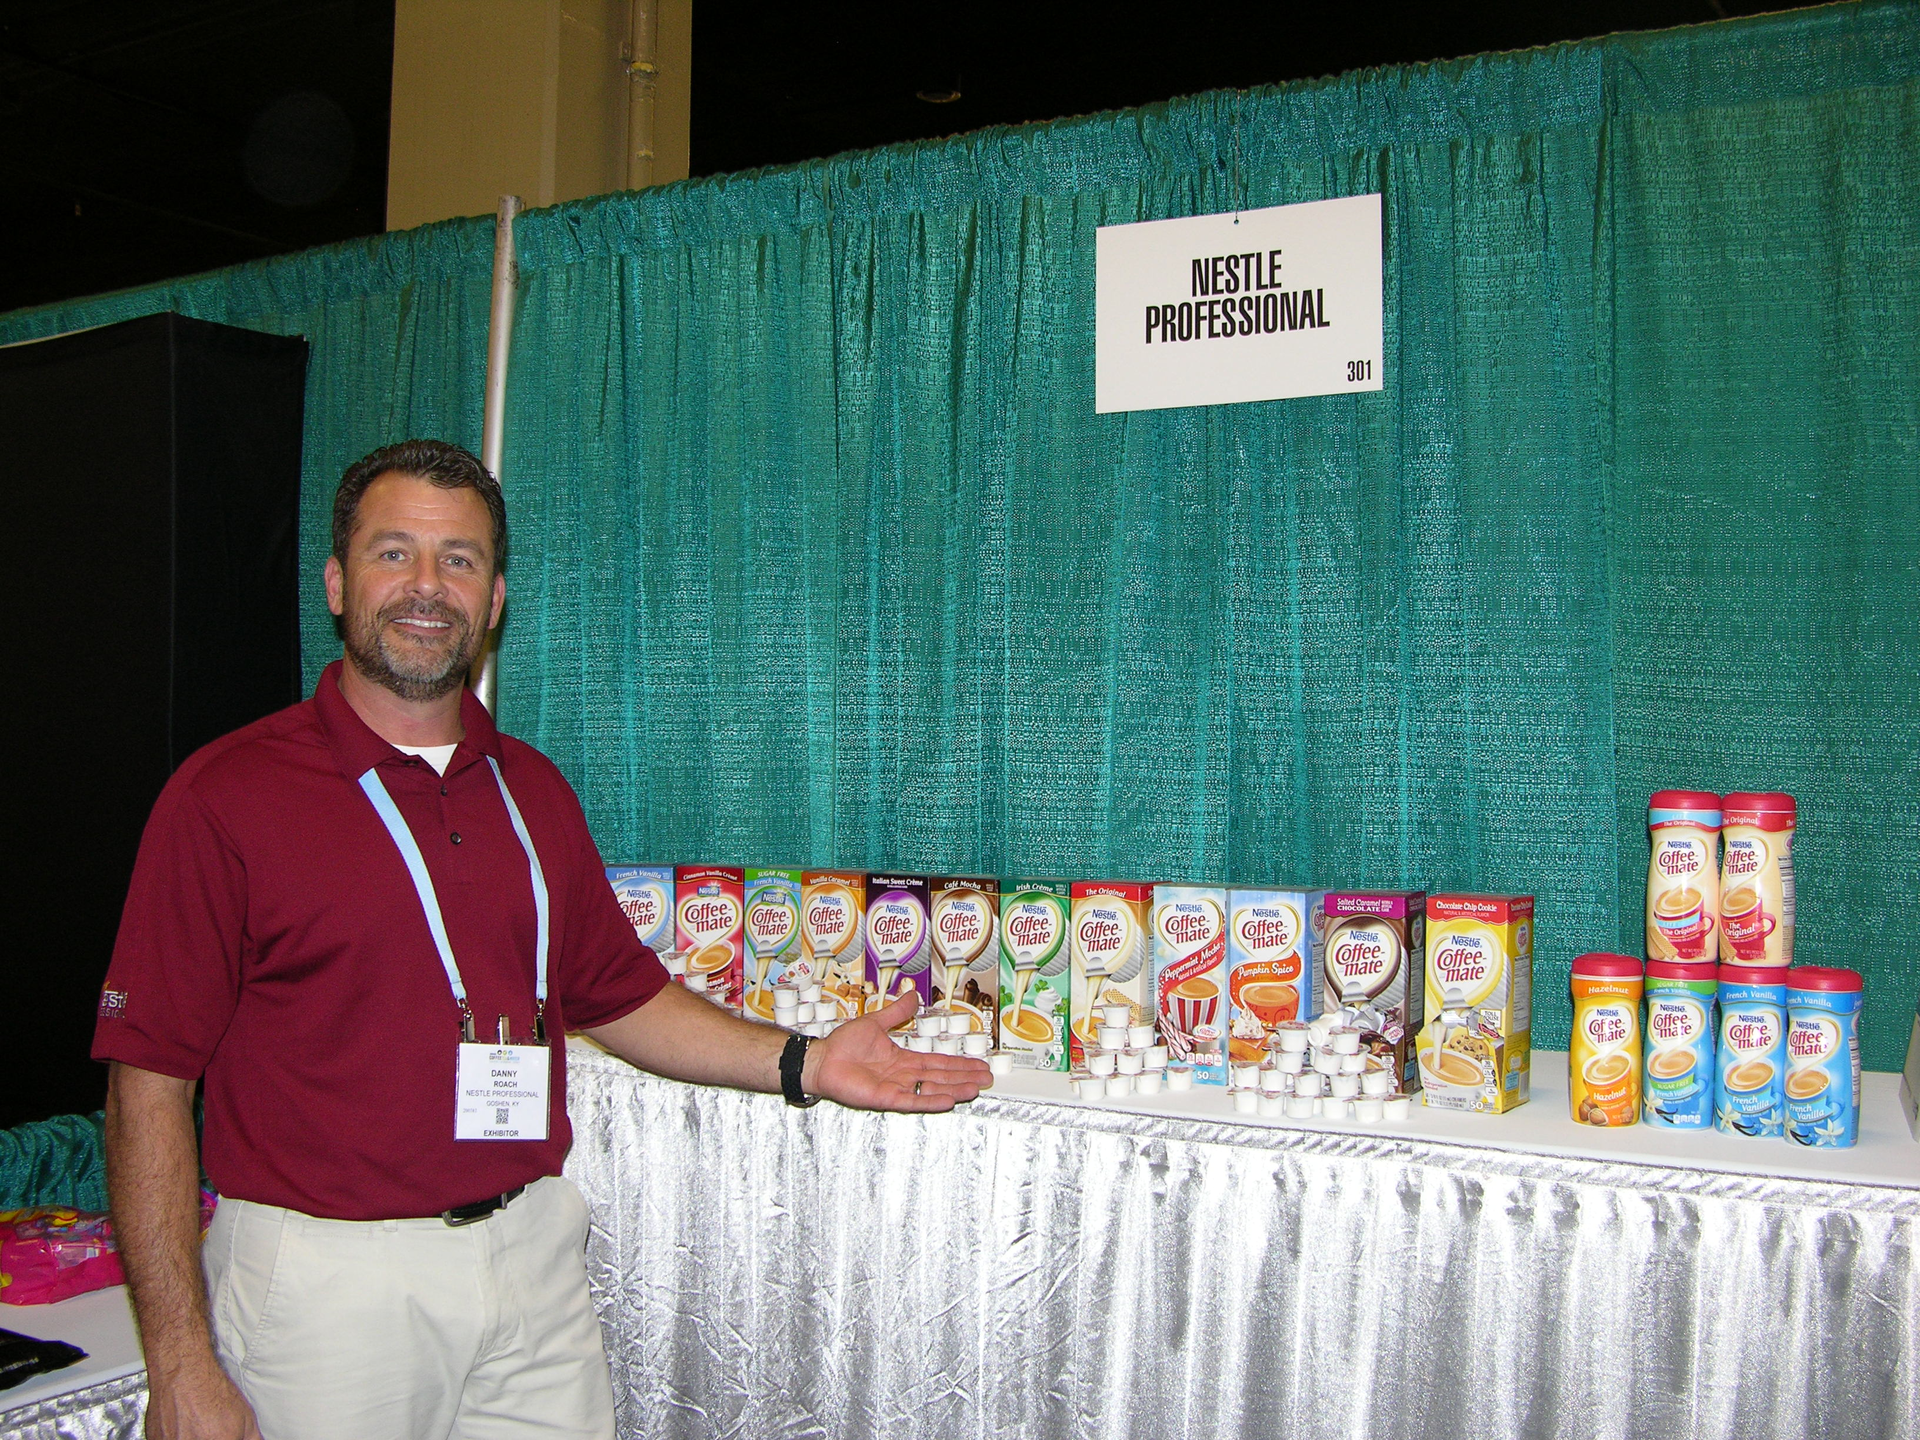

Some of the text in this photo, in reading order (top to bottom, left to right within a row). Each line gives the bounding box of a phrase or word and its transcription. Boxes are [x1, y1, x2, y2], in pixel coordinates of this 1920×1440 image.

[1192, 250, 1282, 297] NESTLE
[1145, 288, 1330, 345] PROFESSIONAL
[1347, 359, 1372, 382] 301
[1730, 816, 1758, 825] Original
[1666, 860, 1699, 876] mate
[1728, 860, 1758, 874] mate
[616, 870, 637, 879] French
[640, 870, 662, 879] Vanilla
[683, 870, 705, 880] Cinnamon
[758, 870, 776, 878] SUGAR
[754, 878, 772, 886] French
[774, 878, 794, 888] Vanilla
[810, 876, 828, 885] Vanilla
[828, 876, 851, 886] Caramel
[944, 880, 958, 889] Café
[960, 881, 981, 890] Mocha
[1016, 883, 1030, 891] Irish
[1032, 884, 1053, 892] Crème
[1086, 888, 1126, 898] The Original
[1337, 898, 1354, 906] Salted
[1436, 901, 1497, 912] Chocolate Chip Cookie
[696, 916, 732, 933] mate
[758, 923, 788, 936] mate
[816, 921, 844, 936] mate
[1674, 924, 1698, 936] Original
[947, 927, 979, 943] mate
[1176, 927, 1210, 944] mate
[1726, 924, 1755, 938] Original
[881, 931, 912, 945] mate
[1017, 931, 1051, 946] mate
[1253, 932, 1288, 950] mate
[1087, 937, 1121, 953] mate
[1165, 942, 1220, 982] Peppermint Mocha
[1344, 960, 1383, 976] mate
[1238, 963, 1270, 980] Pumpkin
[1272, 962, 1294, 976] Spice
[1445, 966, 1485, 982] mate
[1588, 985, 1629, 994] Hazelnut
[1726, 990, 1776, 1000] French Vanilla
[1804, 996, 1832, 1008] Vanilla
[1040, 1059, 1050, 1067] 50
[1197, 1071, 1209, 1080] 50
[492, 1090, 539, 1098] PROFESSIONAL
[1594, 1088, 1627, 1100] Hazelnut
[1733, 1096, 1758, 1104] French
[1470, 1101, 1483, 1109] 50
[1742, 1100, 1770, 1112] Vanilla
[1790, 1104, 1812, 1112] French
[1797, 1108, 1825, 1120] Vanilla
